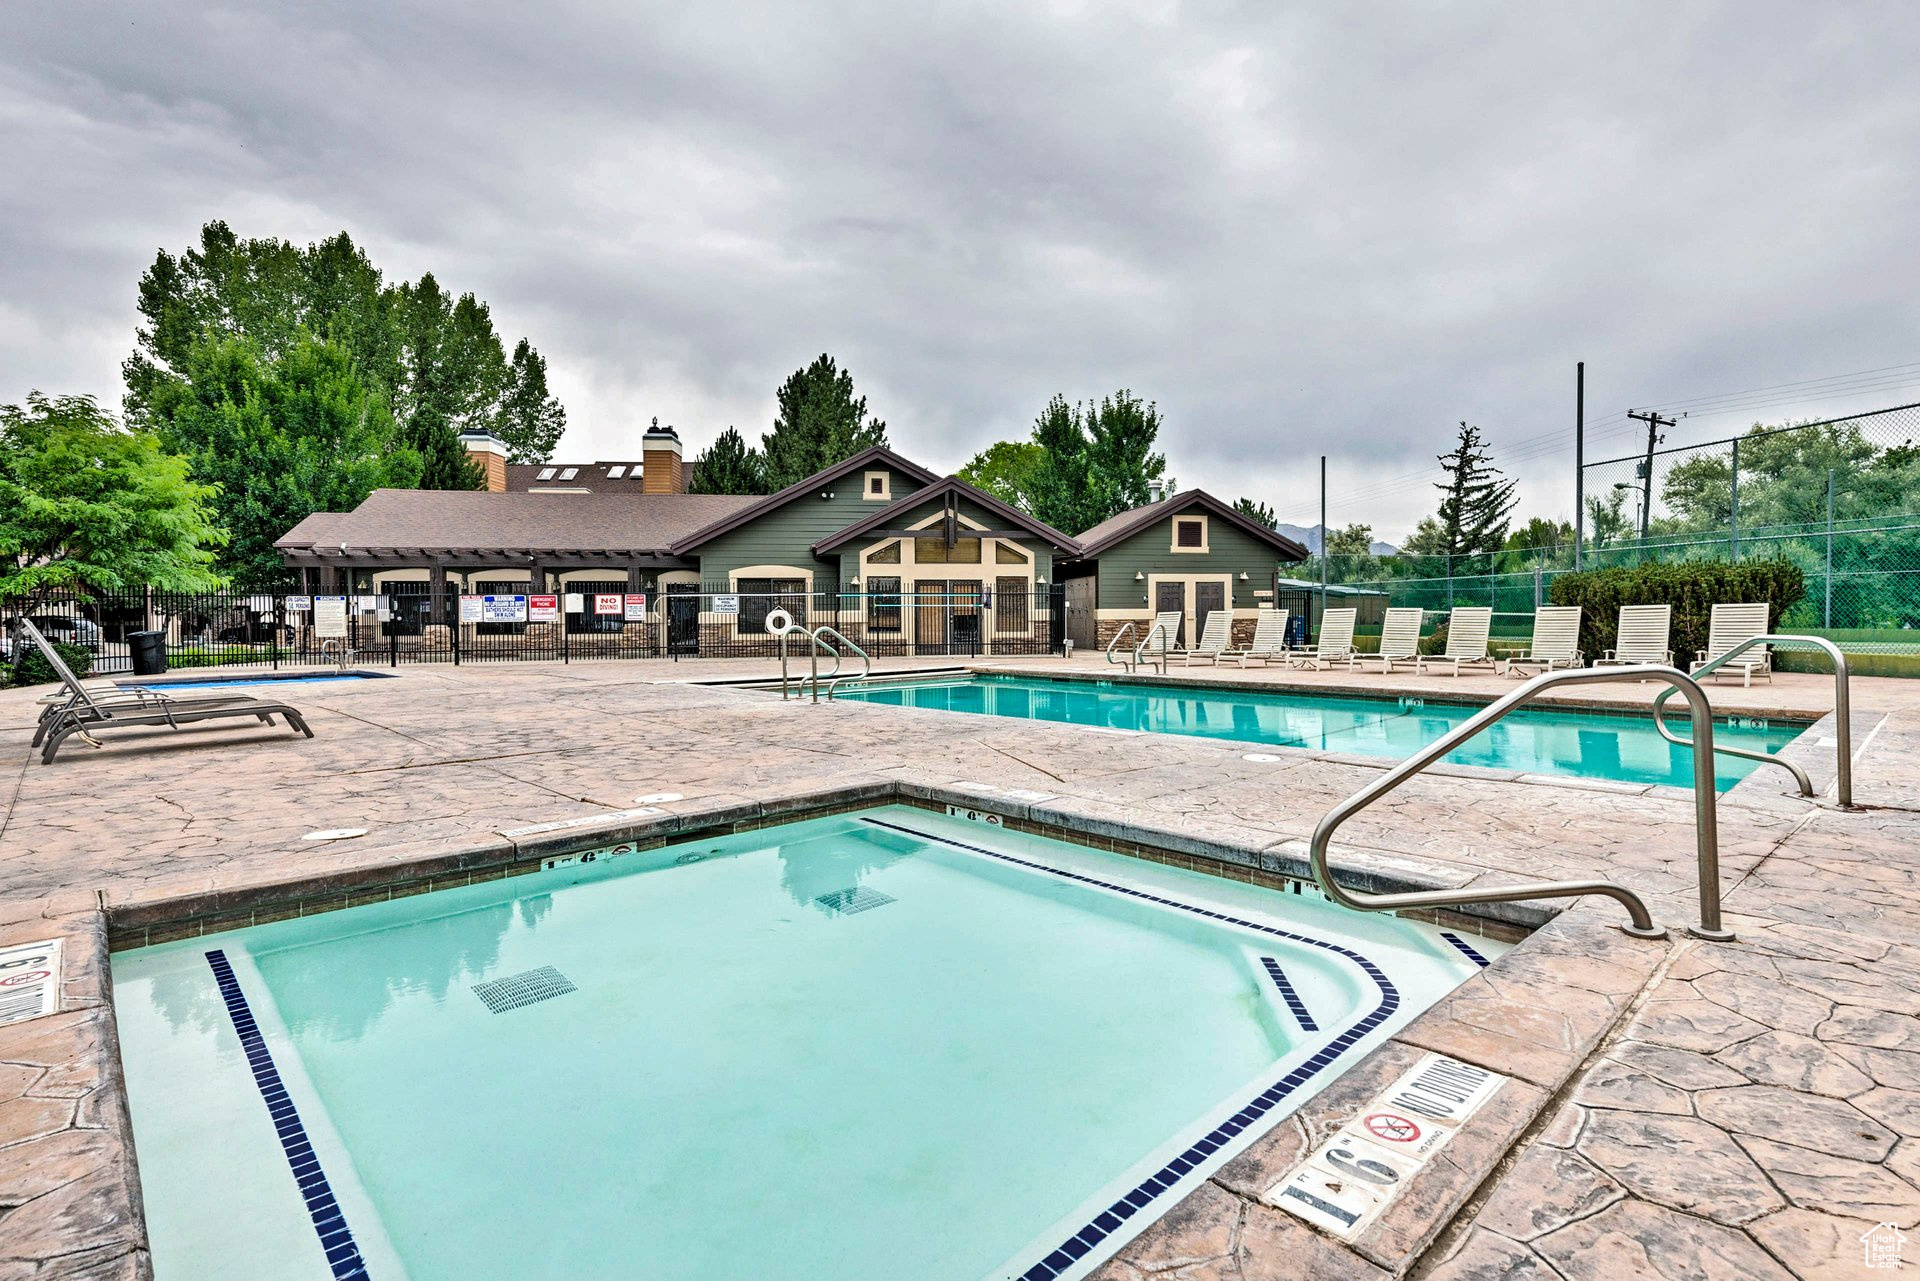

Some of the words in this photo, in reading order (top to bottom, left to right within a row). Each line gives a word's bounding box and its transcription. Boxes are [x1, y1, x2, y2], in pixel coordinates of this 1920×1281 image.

[1410, 1059, 1491, 1105] DIVING
[1390, 1092, 1455, 1119] NO
[1340, 1137, 1352, 1146] IN
[1417, 1142, 1429, 1154] NO
[1427, 1130, 1444, 1148] DIVING
[1296, 1172, 1310, 1184] FT
[1325, 1148, 1400, 1185] 6
[1280, 1184, 1363, 1229] 1
